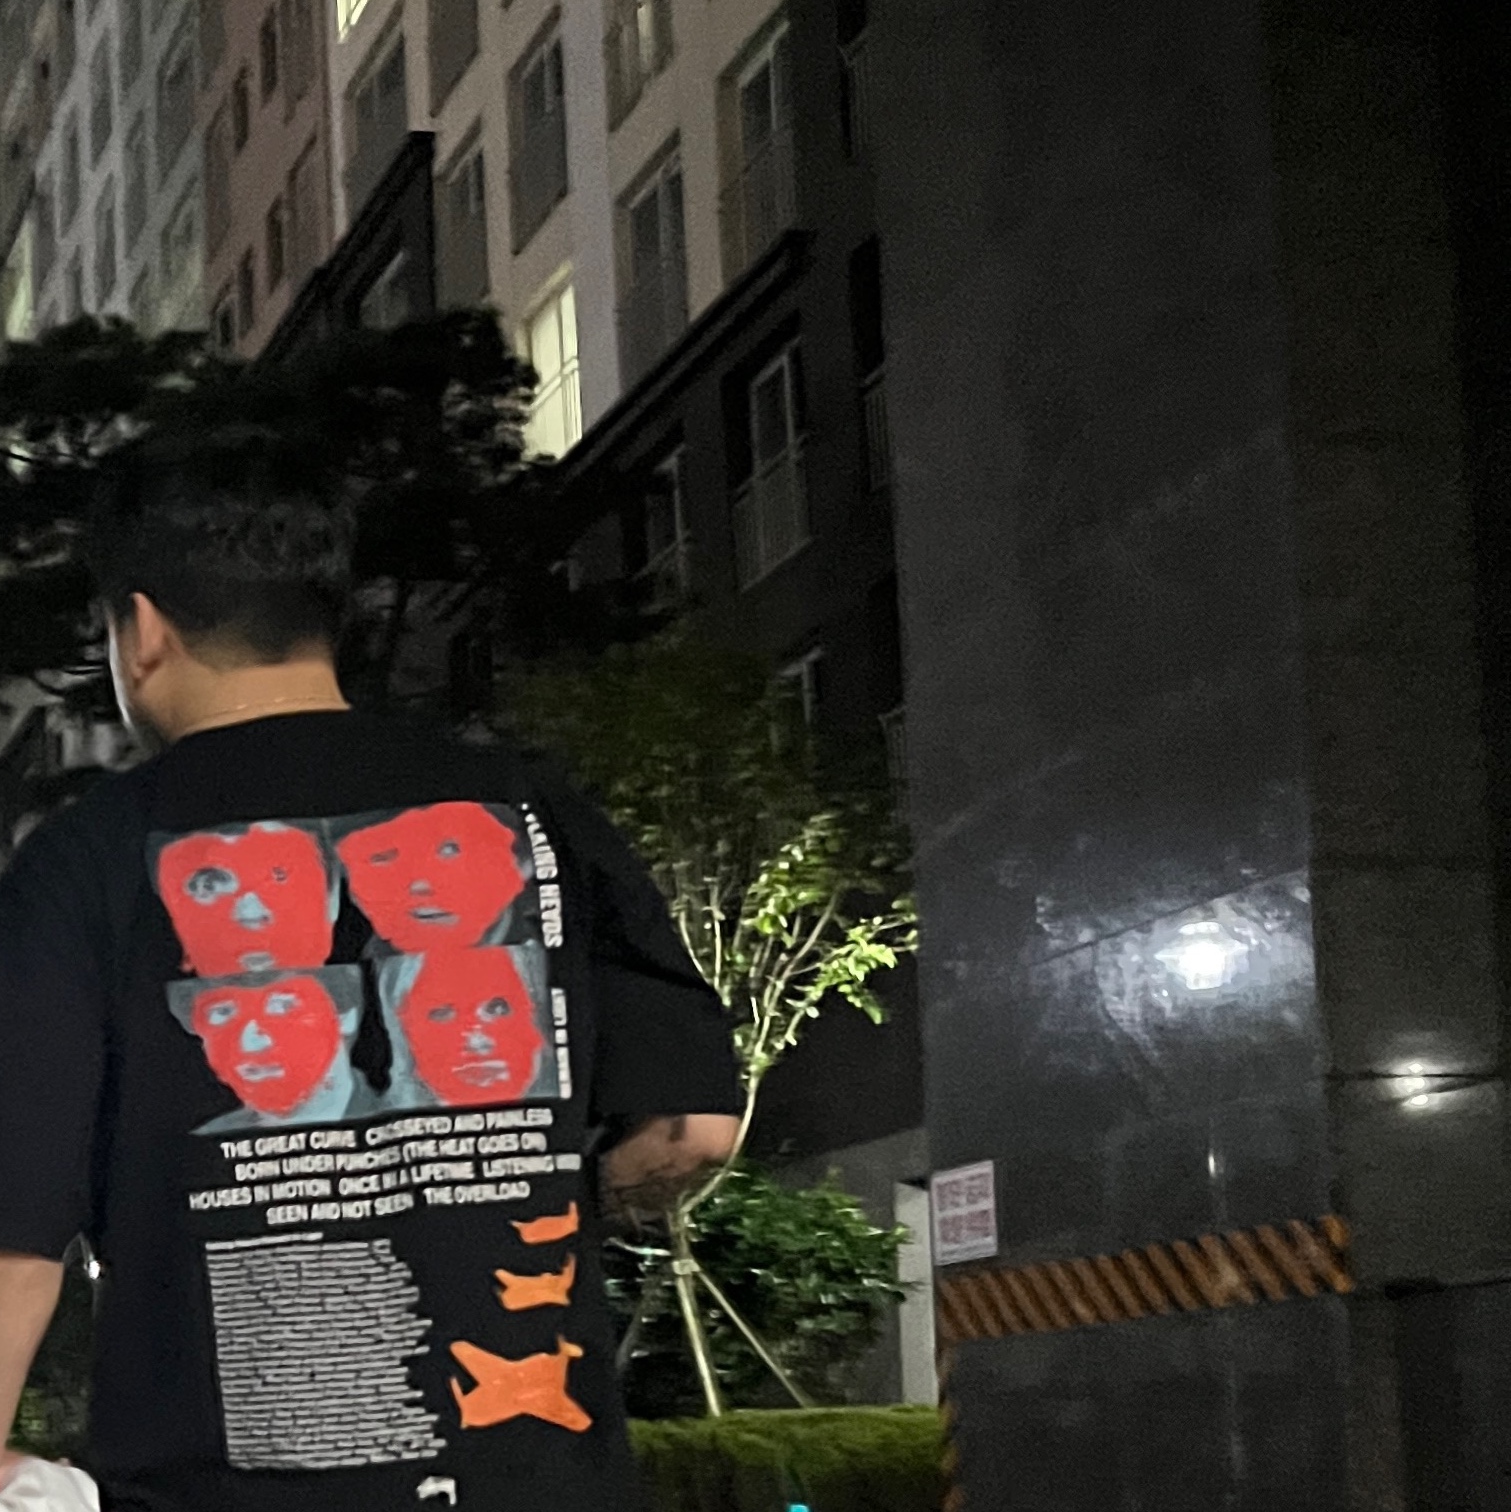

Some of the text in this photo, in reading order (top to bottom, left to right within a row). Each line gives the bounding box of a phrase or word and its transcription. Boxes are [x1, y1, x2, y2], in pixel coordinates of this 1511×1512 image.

[220, 1139, 253, 1158] THE
[255, 1132, 307, 1156] GREAT
[189, 1186, 252, 1209] HOUSES
